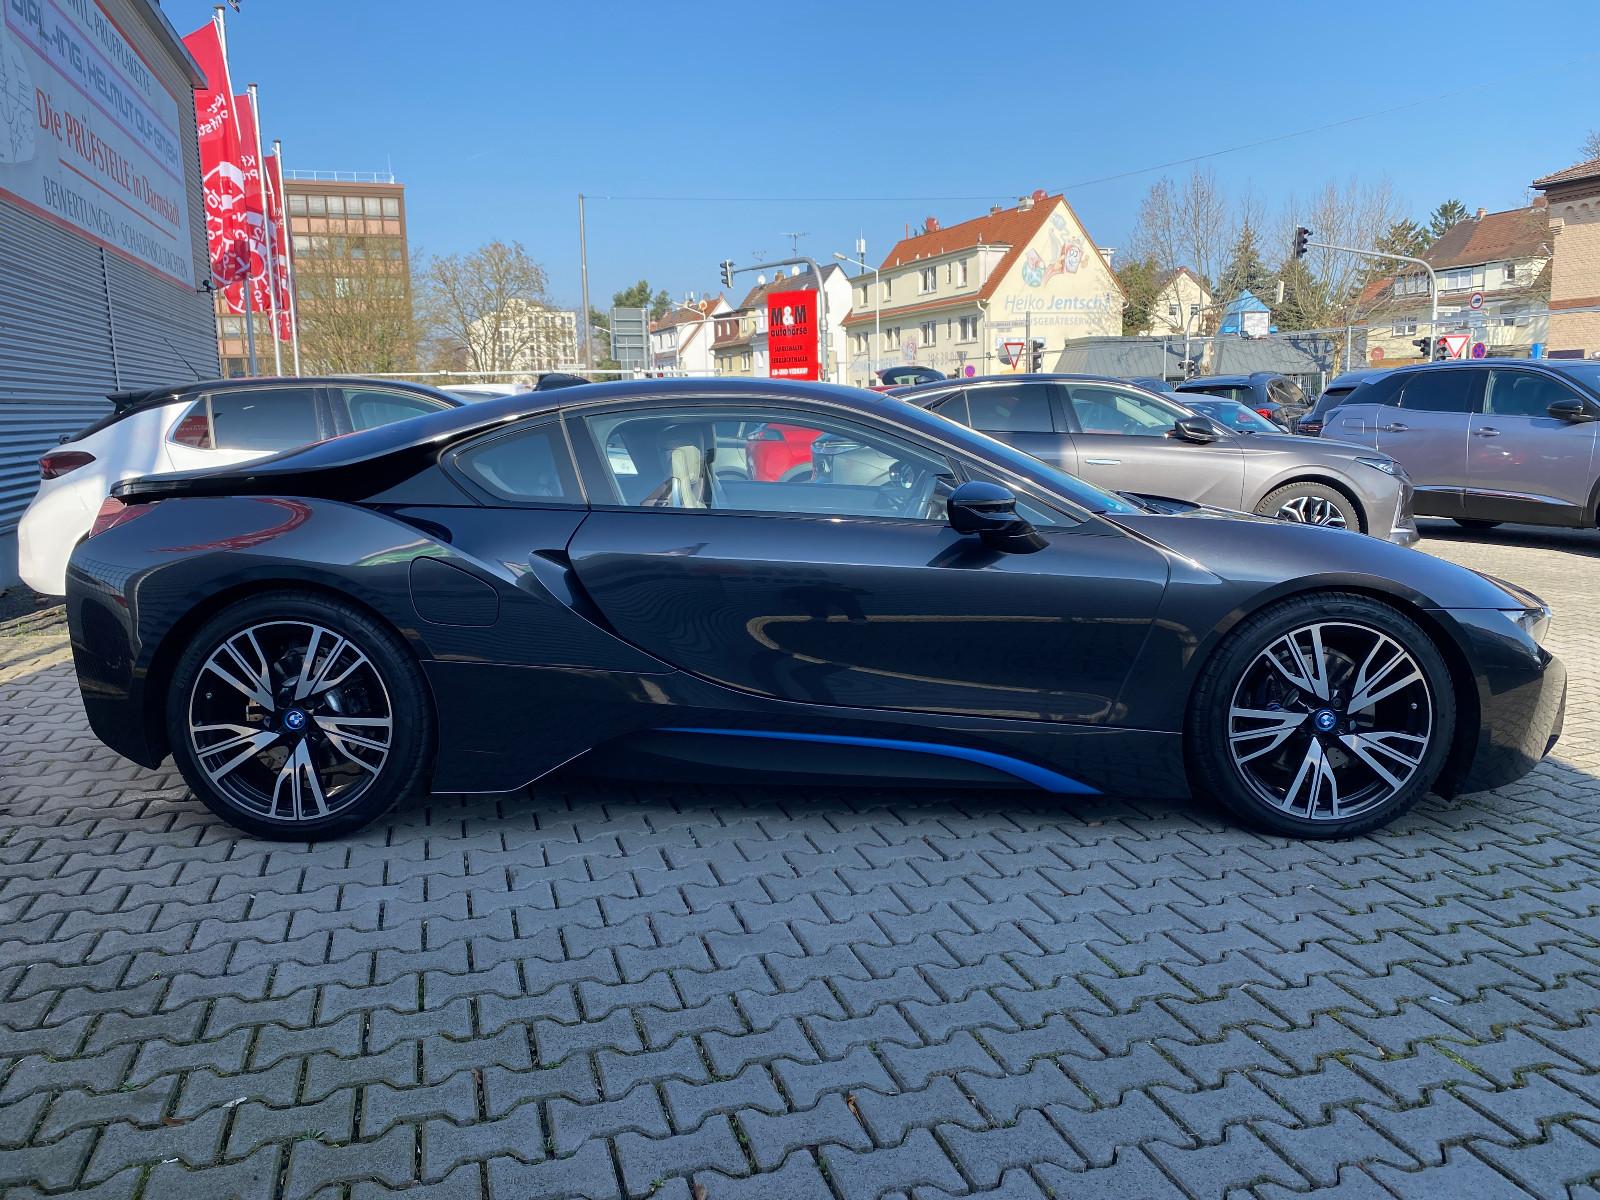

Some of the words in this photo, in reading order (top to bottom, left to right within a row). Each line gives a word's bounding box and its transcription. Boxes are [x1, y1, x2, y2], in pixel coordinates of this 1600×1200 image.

[86, 55, 134, 125] HELMUT
[36, 87, 63, 142] Die
[64, 110, 131, 193] PRÜFSTELLE
[131, 163, 143, 201] in
[143, 175, 181, 230] Darmstadt
[43, 175, 117, 241] BEWERTUNGEN
[771, 304, 807, 327] M&M
[1005, 294, 1045, 311] Heiko
[1047, 294, 1103, 311] Jentsch
